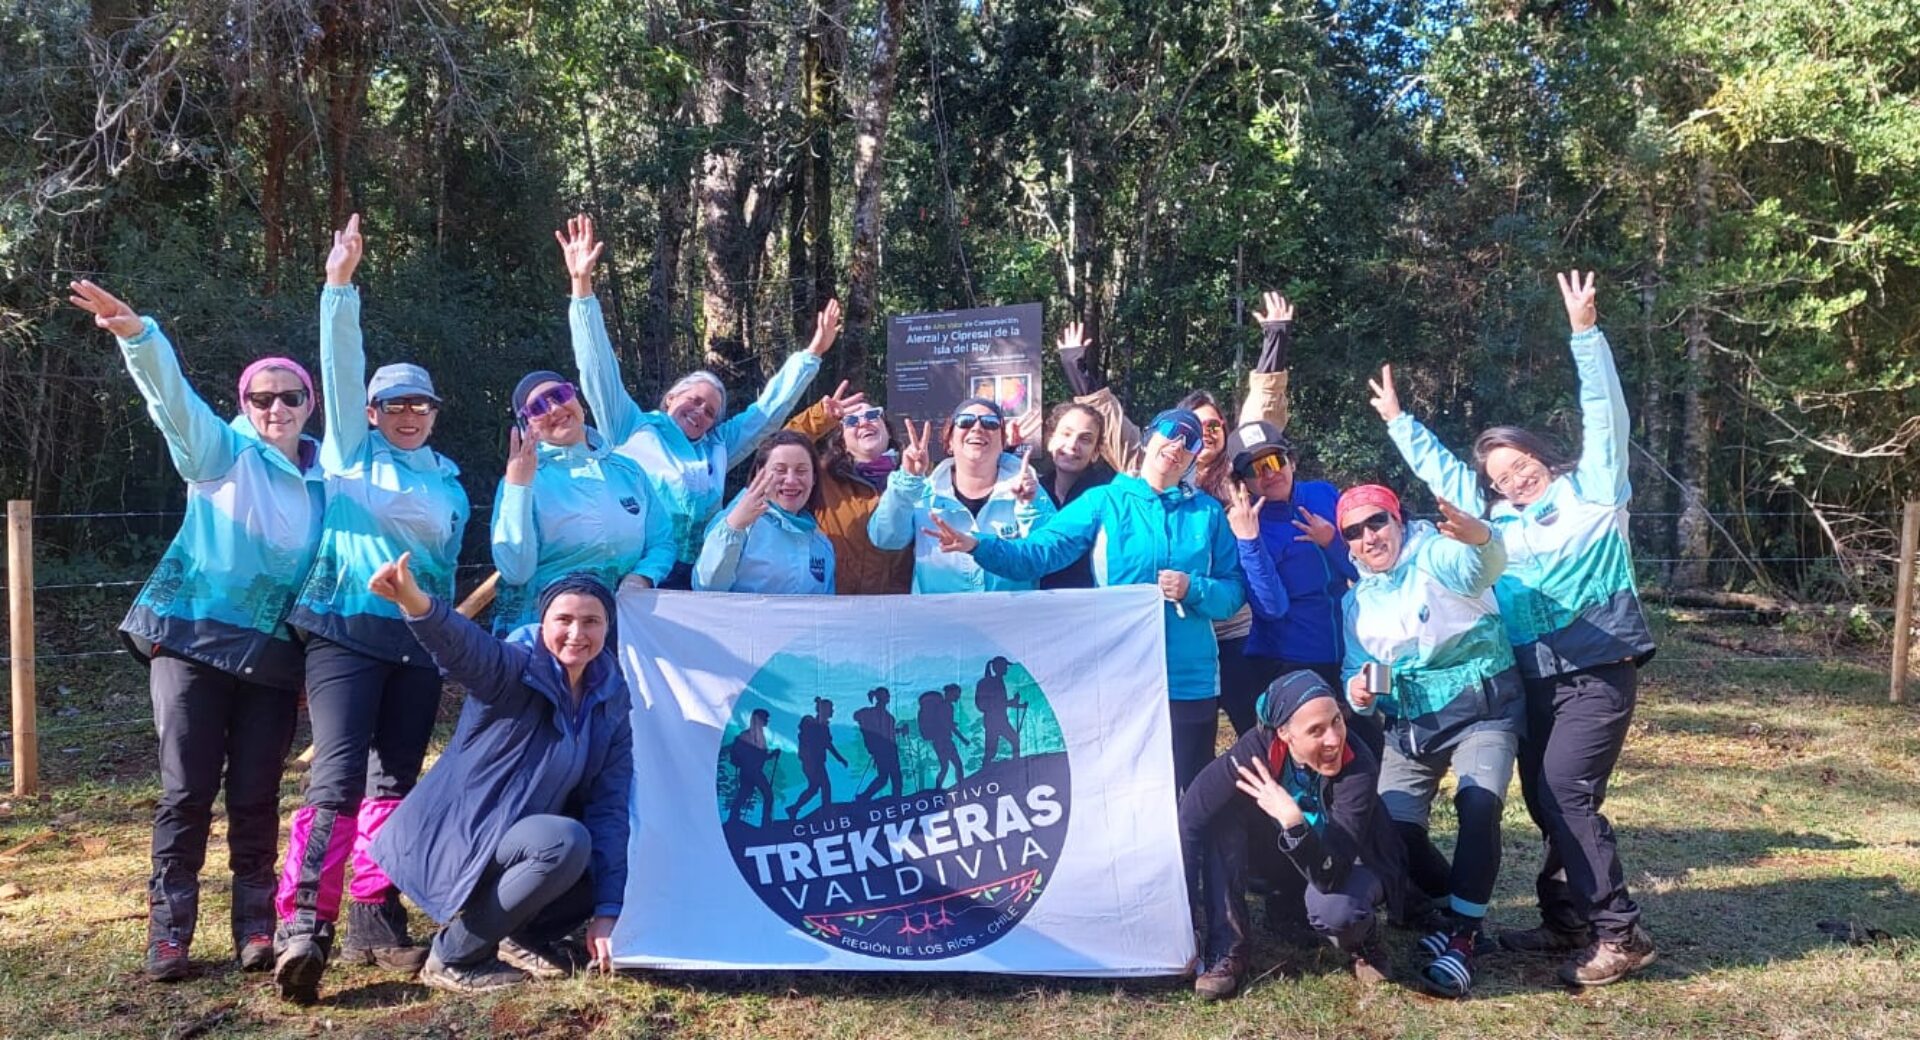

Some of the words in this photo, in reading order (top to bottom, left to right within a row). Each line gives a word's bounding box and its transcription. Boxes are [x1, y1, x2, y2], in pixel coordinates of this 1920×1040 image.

[906, 333, 940, 344] Alerzal
[942, 334, 948, 343] y
[951, 330, 991, 341] Cipresal
[995, 328, 1007, 337] de
[1011, 327, 1019, 336] la
[974, 318, 1019, 327] Conservación
[934, 346, 950, 354] Isla
[953, 344, 968, 353] del
[972, 343, 991, 354] Rey
[744, 784, 1063, 885] TREKKERAS
[793, 817, 851, 836] CLUB
[869, 782, 999, 822] DEPORTIVO
[781, 837, 1049, 910] VALDIVIA
[841, 935, 891, 955] REGIÓN
[896, 946, 914, 956] DE
[918, 944, 943, 956] LOS
[947, 935, 976, 952] RÍOS
[987, 905, 1019, 934] CHILE
